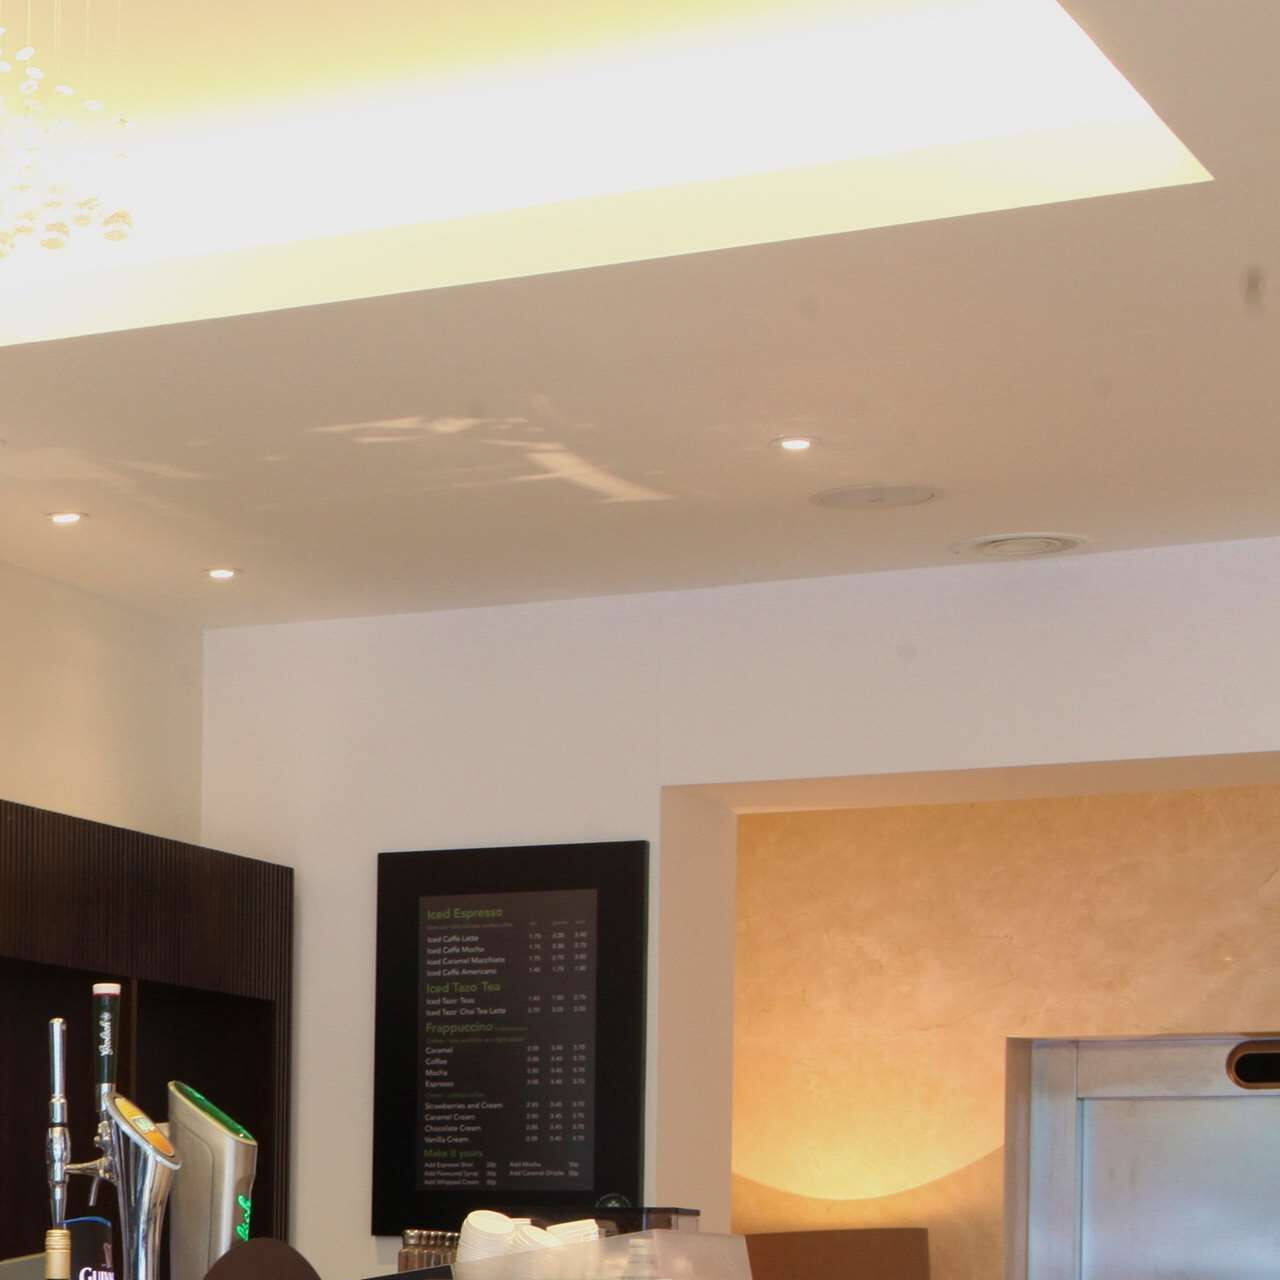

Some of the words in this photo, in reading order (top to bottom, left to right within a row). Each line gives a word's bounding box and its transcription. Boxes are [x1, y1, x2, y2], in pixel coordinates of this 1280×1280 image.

[426, 908, 451, 921] Iced
[453, 906, 504, 922] Espresso
[426, 983, 450, 993] Iced
[481, 981, 502, 993] Tea
[425, 1021, 494, 1037] Frappuccino
